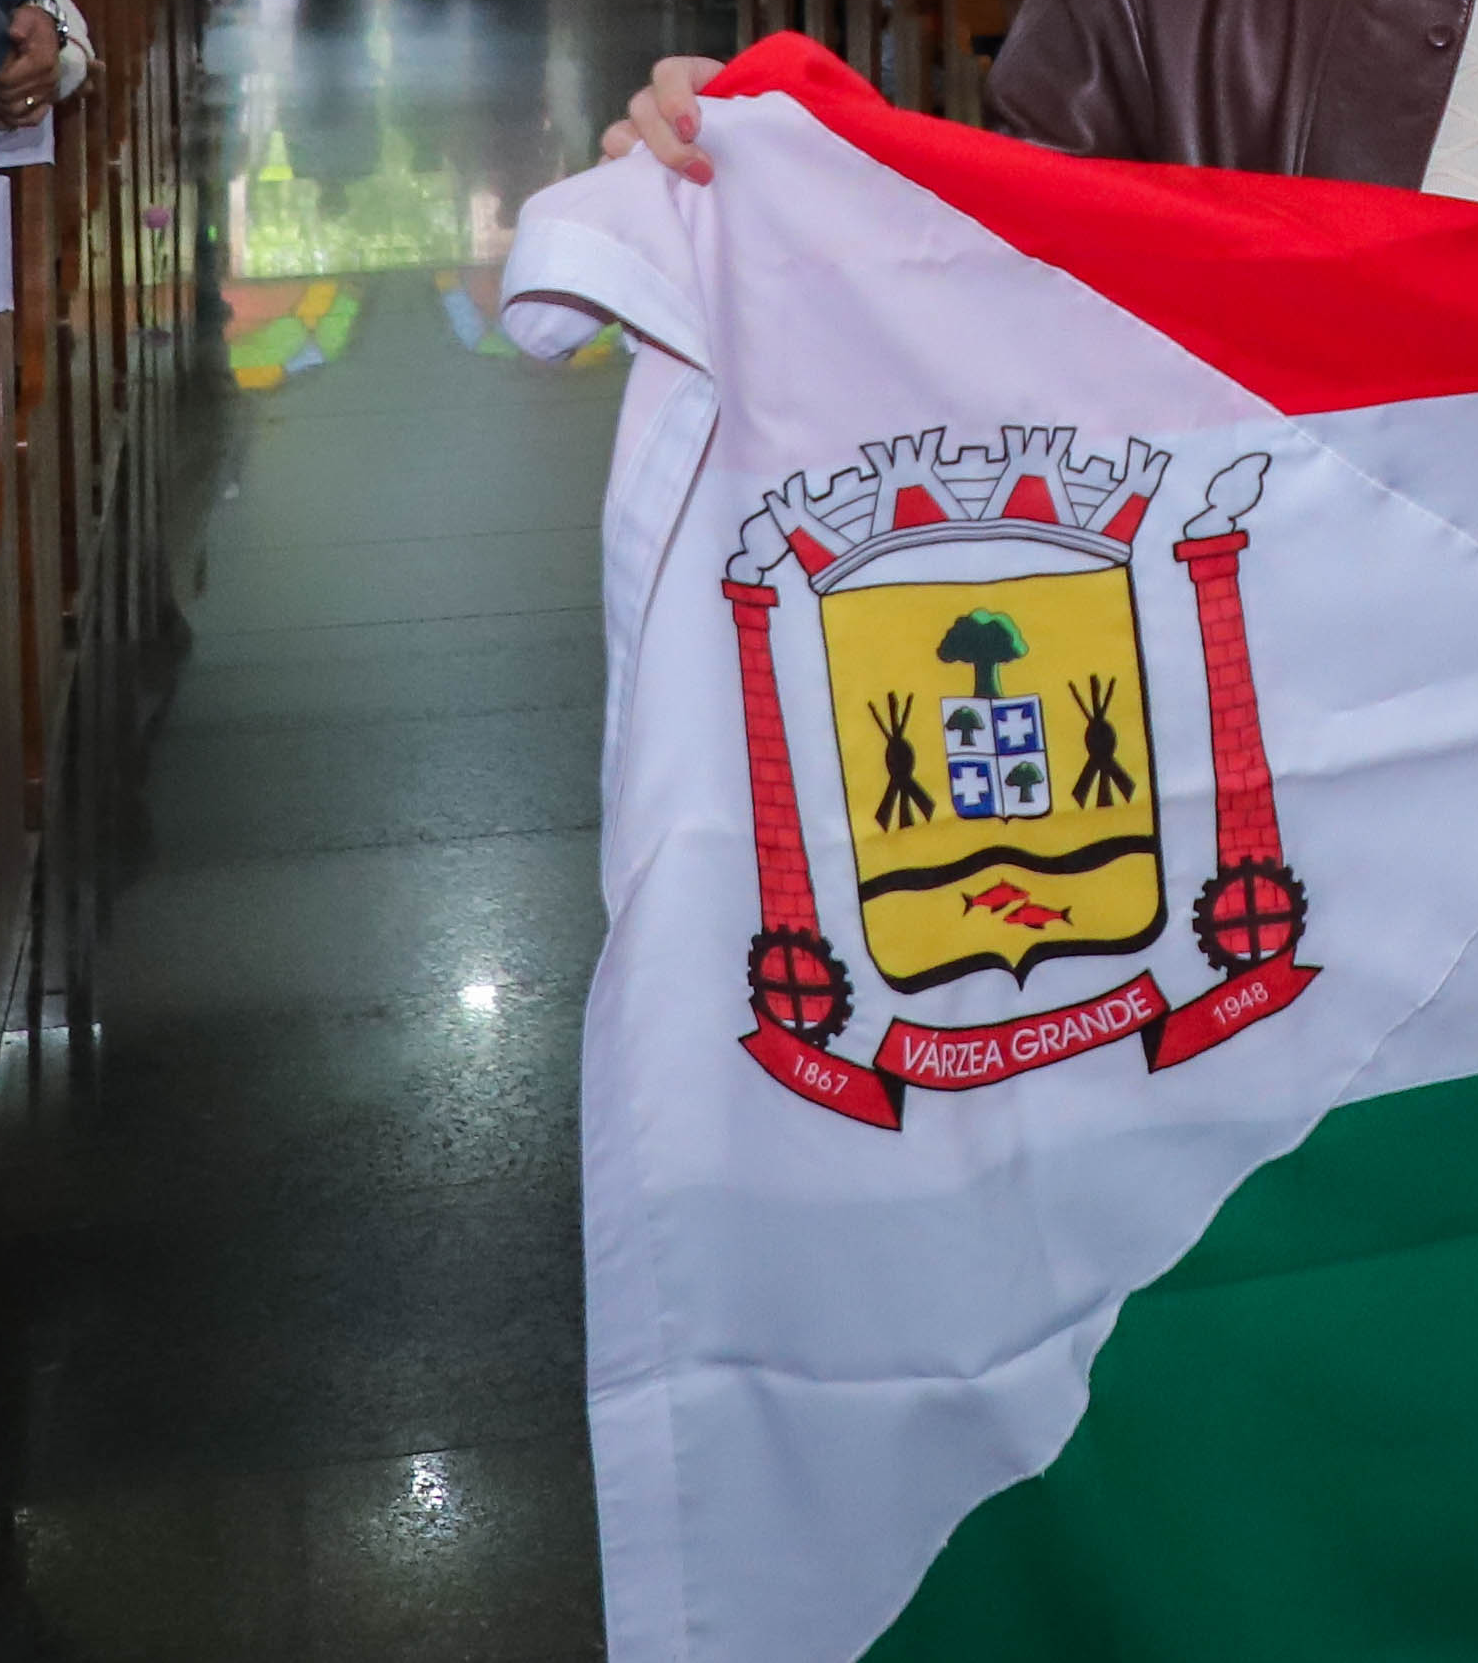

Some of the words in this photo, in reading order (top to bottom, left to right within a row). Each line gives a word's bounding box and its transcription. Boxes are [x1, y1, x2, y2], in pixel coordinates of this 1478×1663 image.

[793, 1054, 849, 1096] 1867
[902, 1031, 1005, 1079] VÁRZEA
[1010, 986, 1154, 1062] GRANDE
[1212, 980, 1270, 1026] 1948
